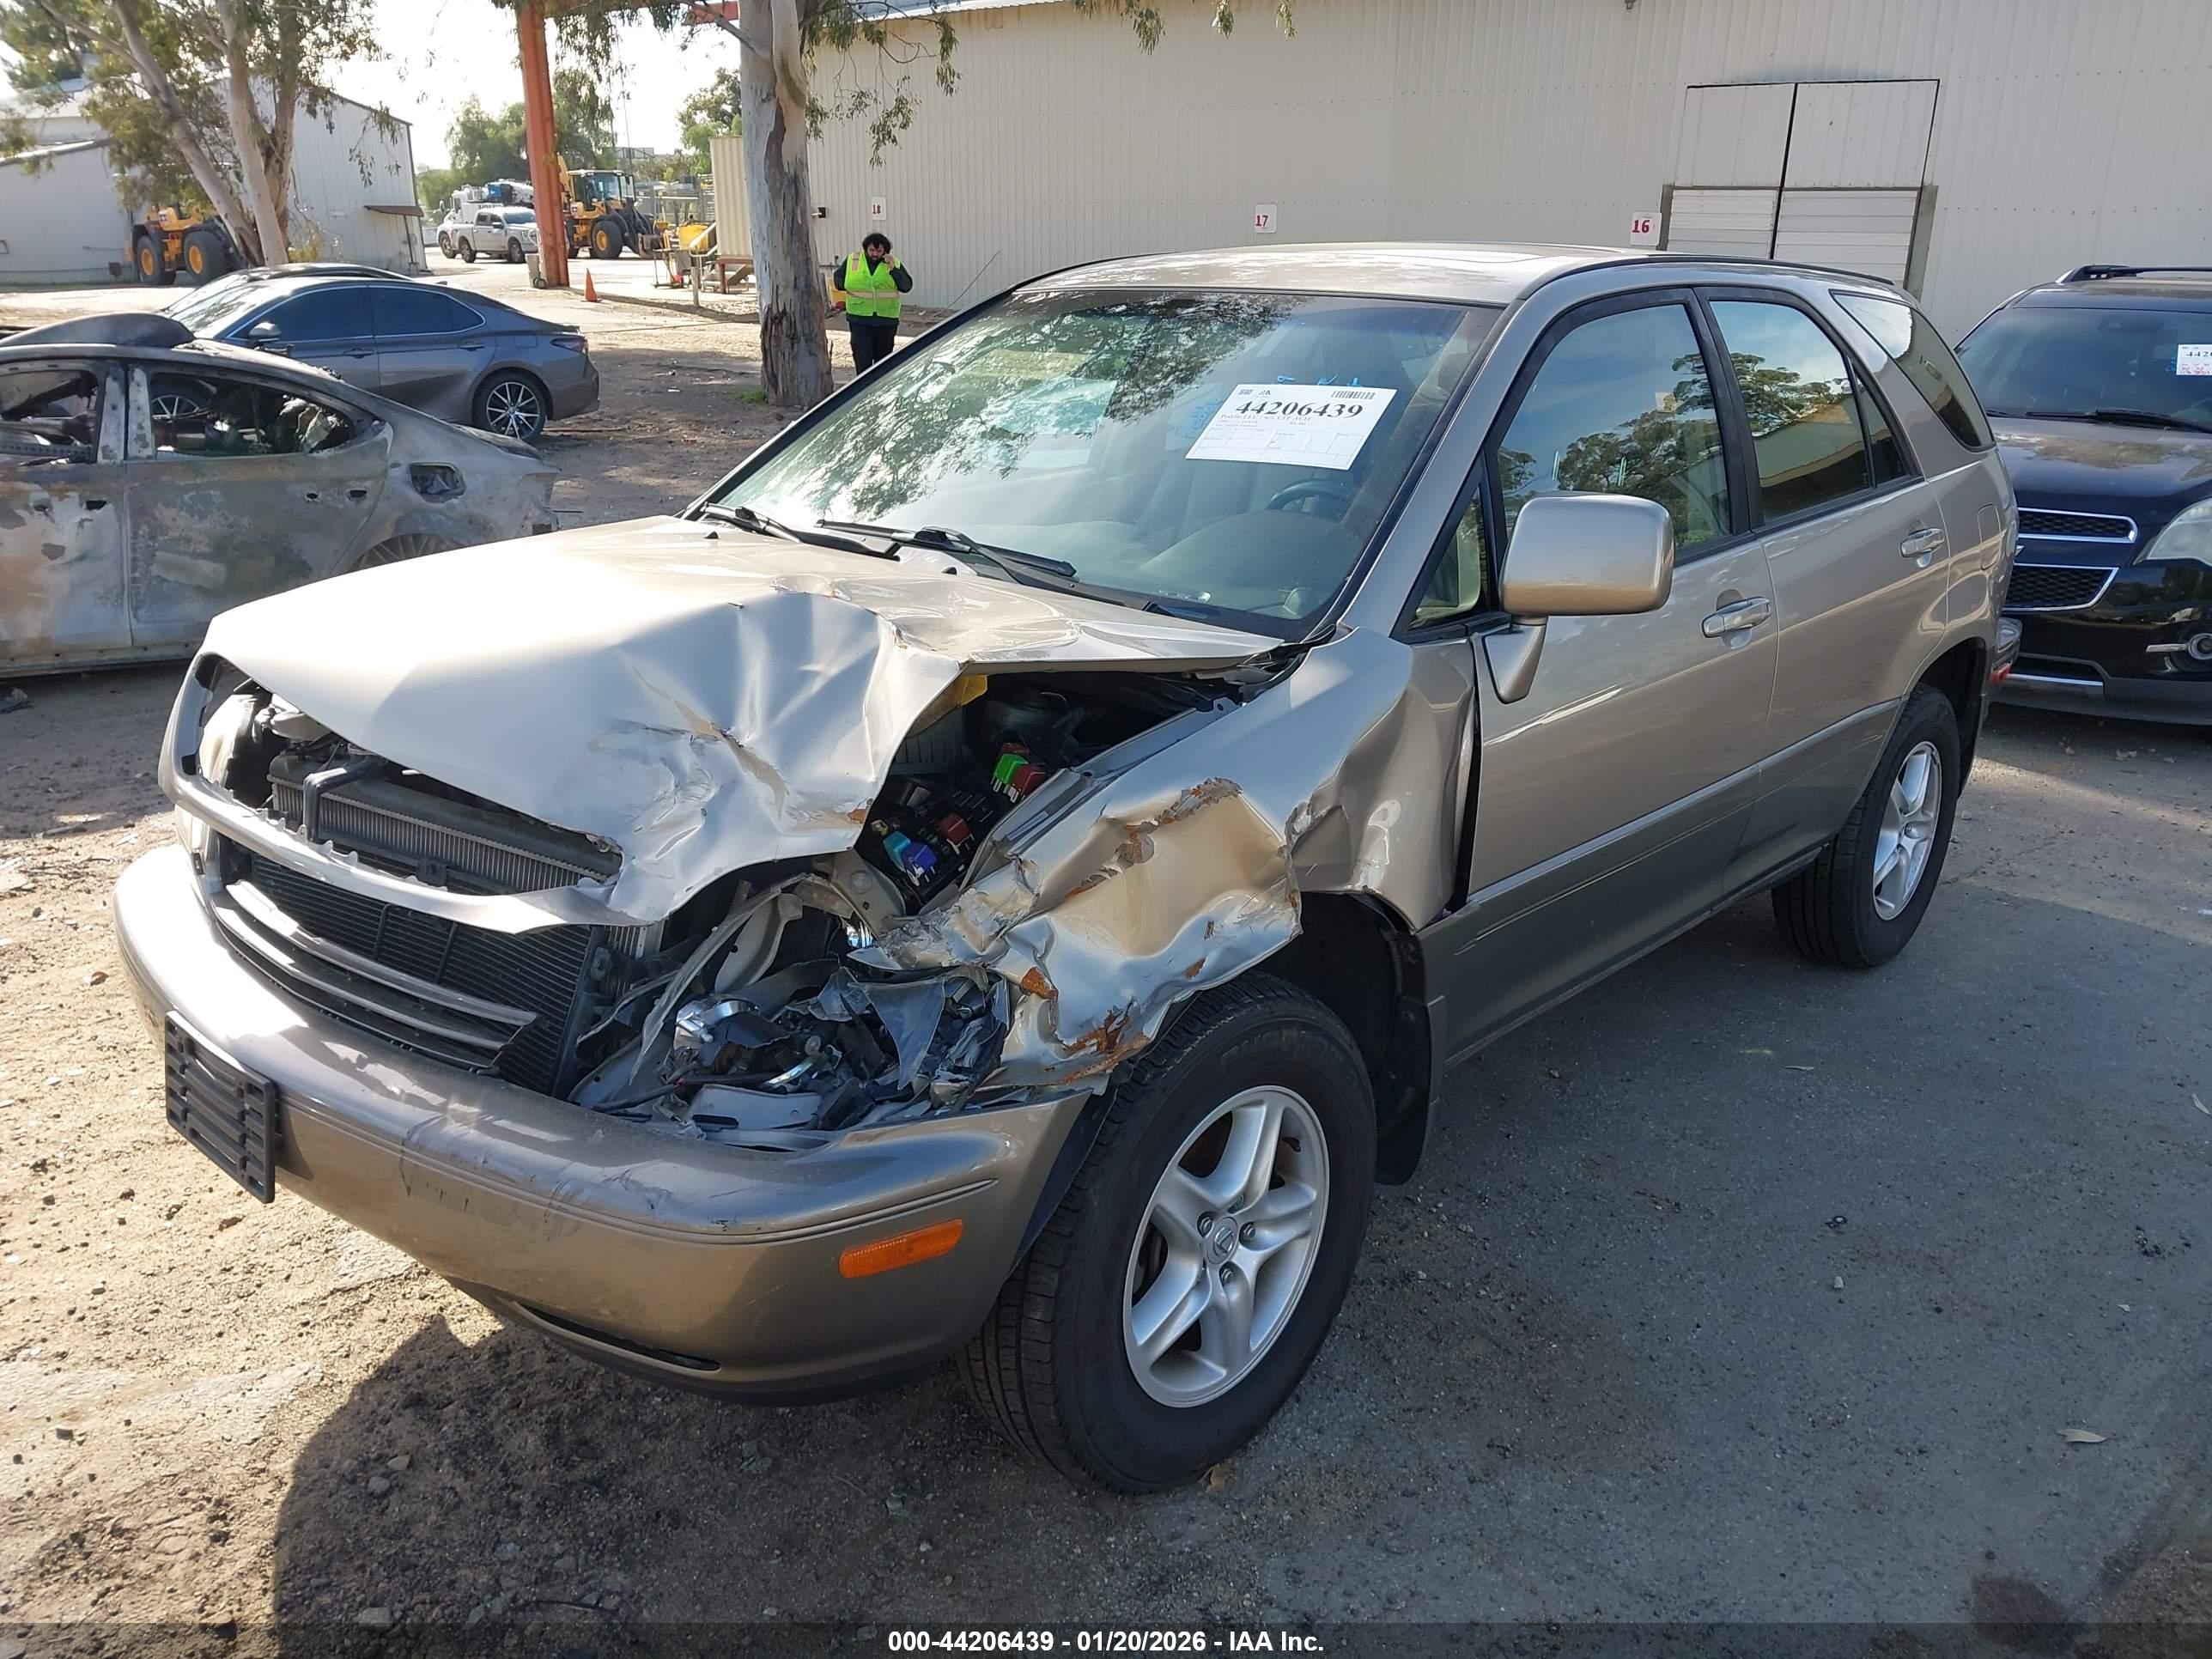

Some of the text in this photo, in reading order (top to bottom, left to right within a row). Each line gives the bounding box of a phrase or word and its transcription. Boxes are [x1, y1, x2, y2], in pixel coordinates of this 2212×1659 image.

[1255, 215, 1268, 227] 17
[1632, 219, 1650, 234] 16
[1236, 400, 1364, 419] 44206439
